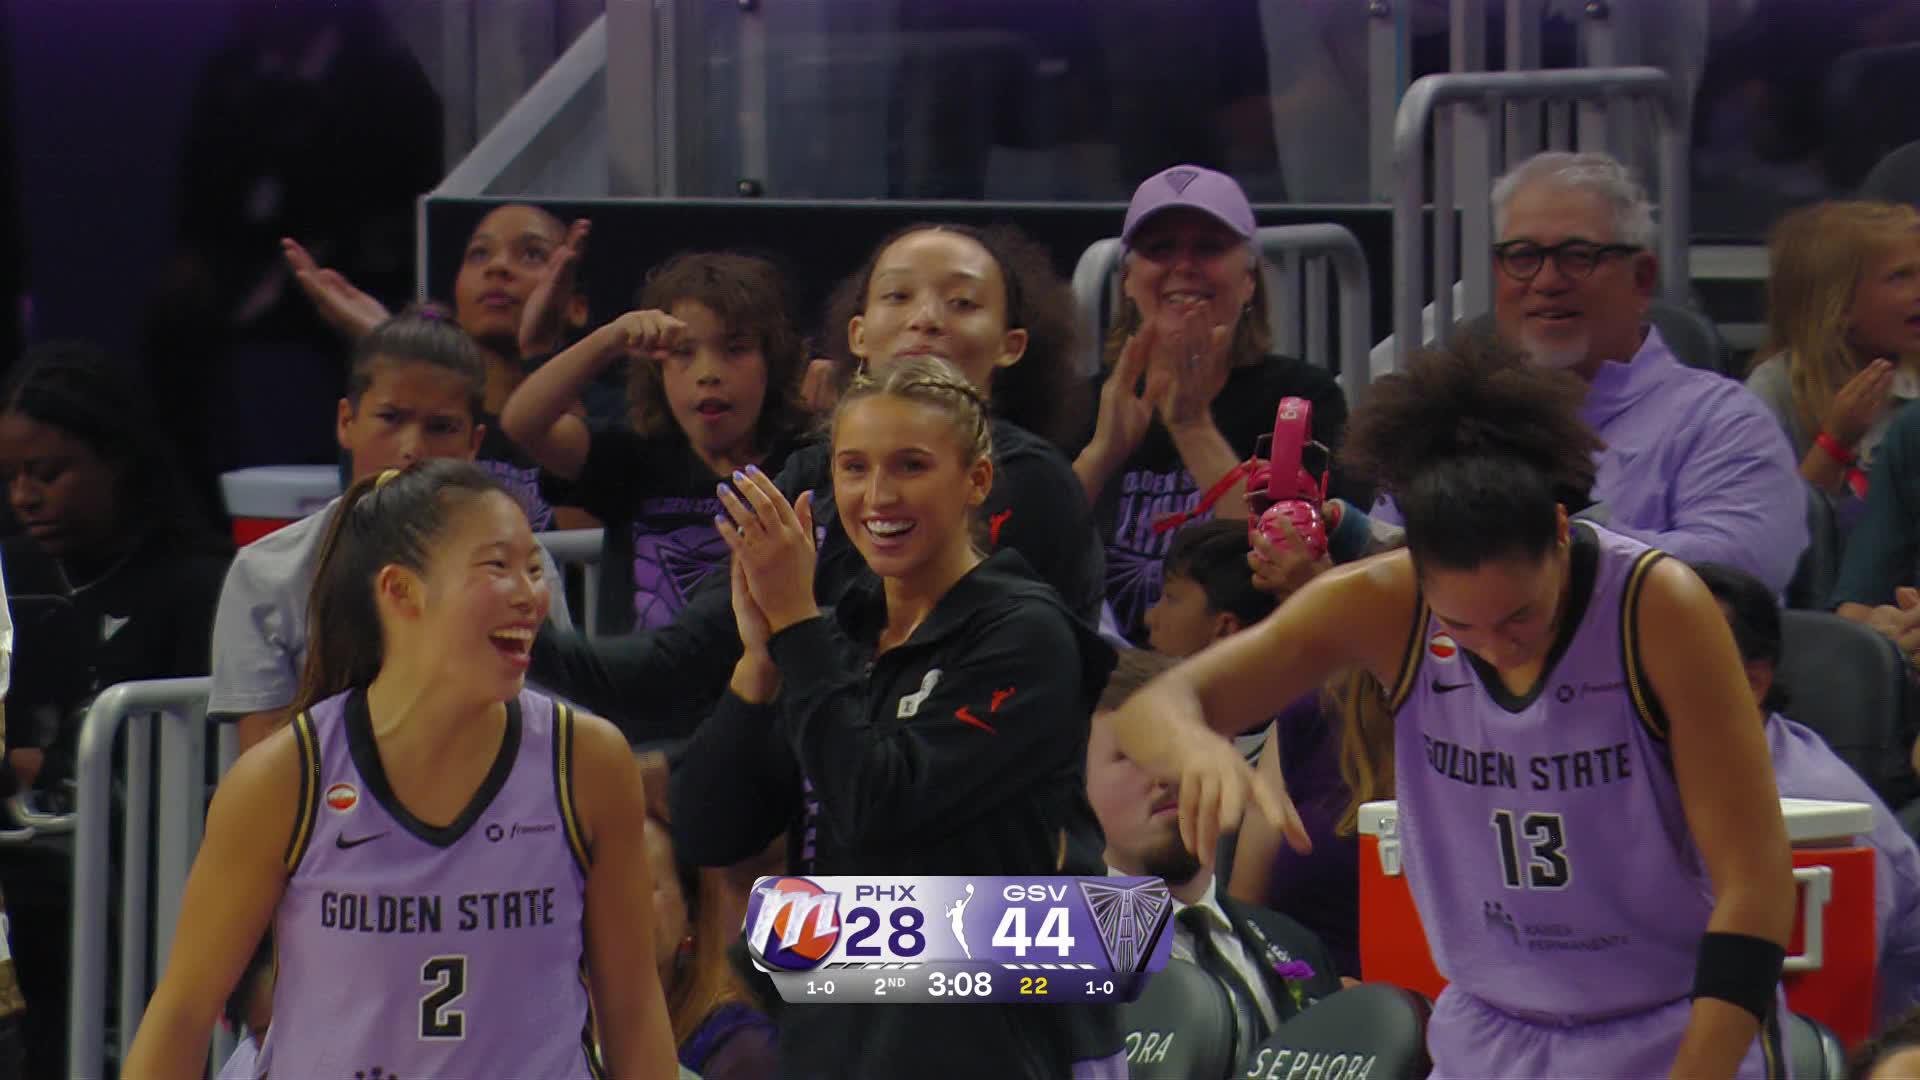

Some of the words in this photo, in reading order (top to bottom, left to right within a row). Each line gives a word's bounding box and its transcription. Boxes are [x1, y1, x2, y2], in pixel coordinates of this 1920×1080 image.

[1530, 743, 1632, 791] STATE
[1489, 808, 1572, 891] 13
[321, 891, 443, 934] GOLDEN
[458, 888, 555, 932] STATE
[419, 954, 467, 1040] 2
[1247, 1048, 1377, 1080] SEPHORA
